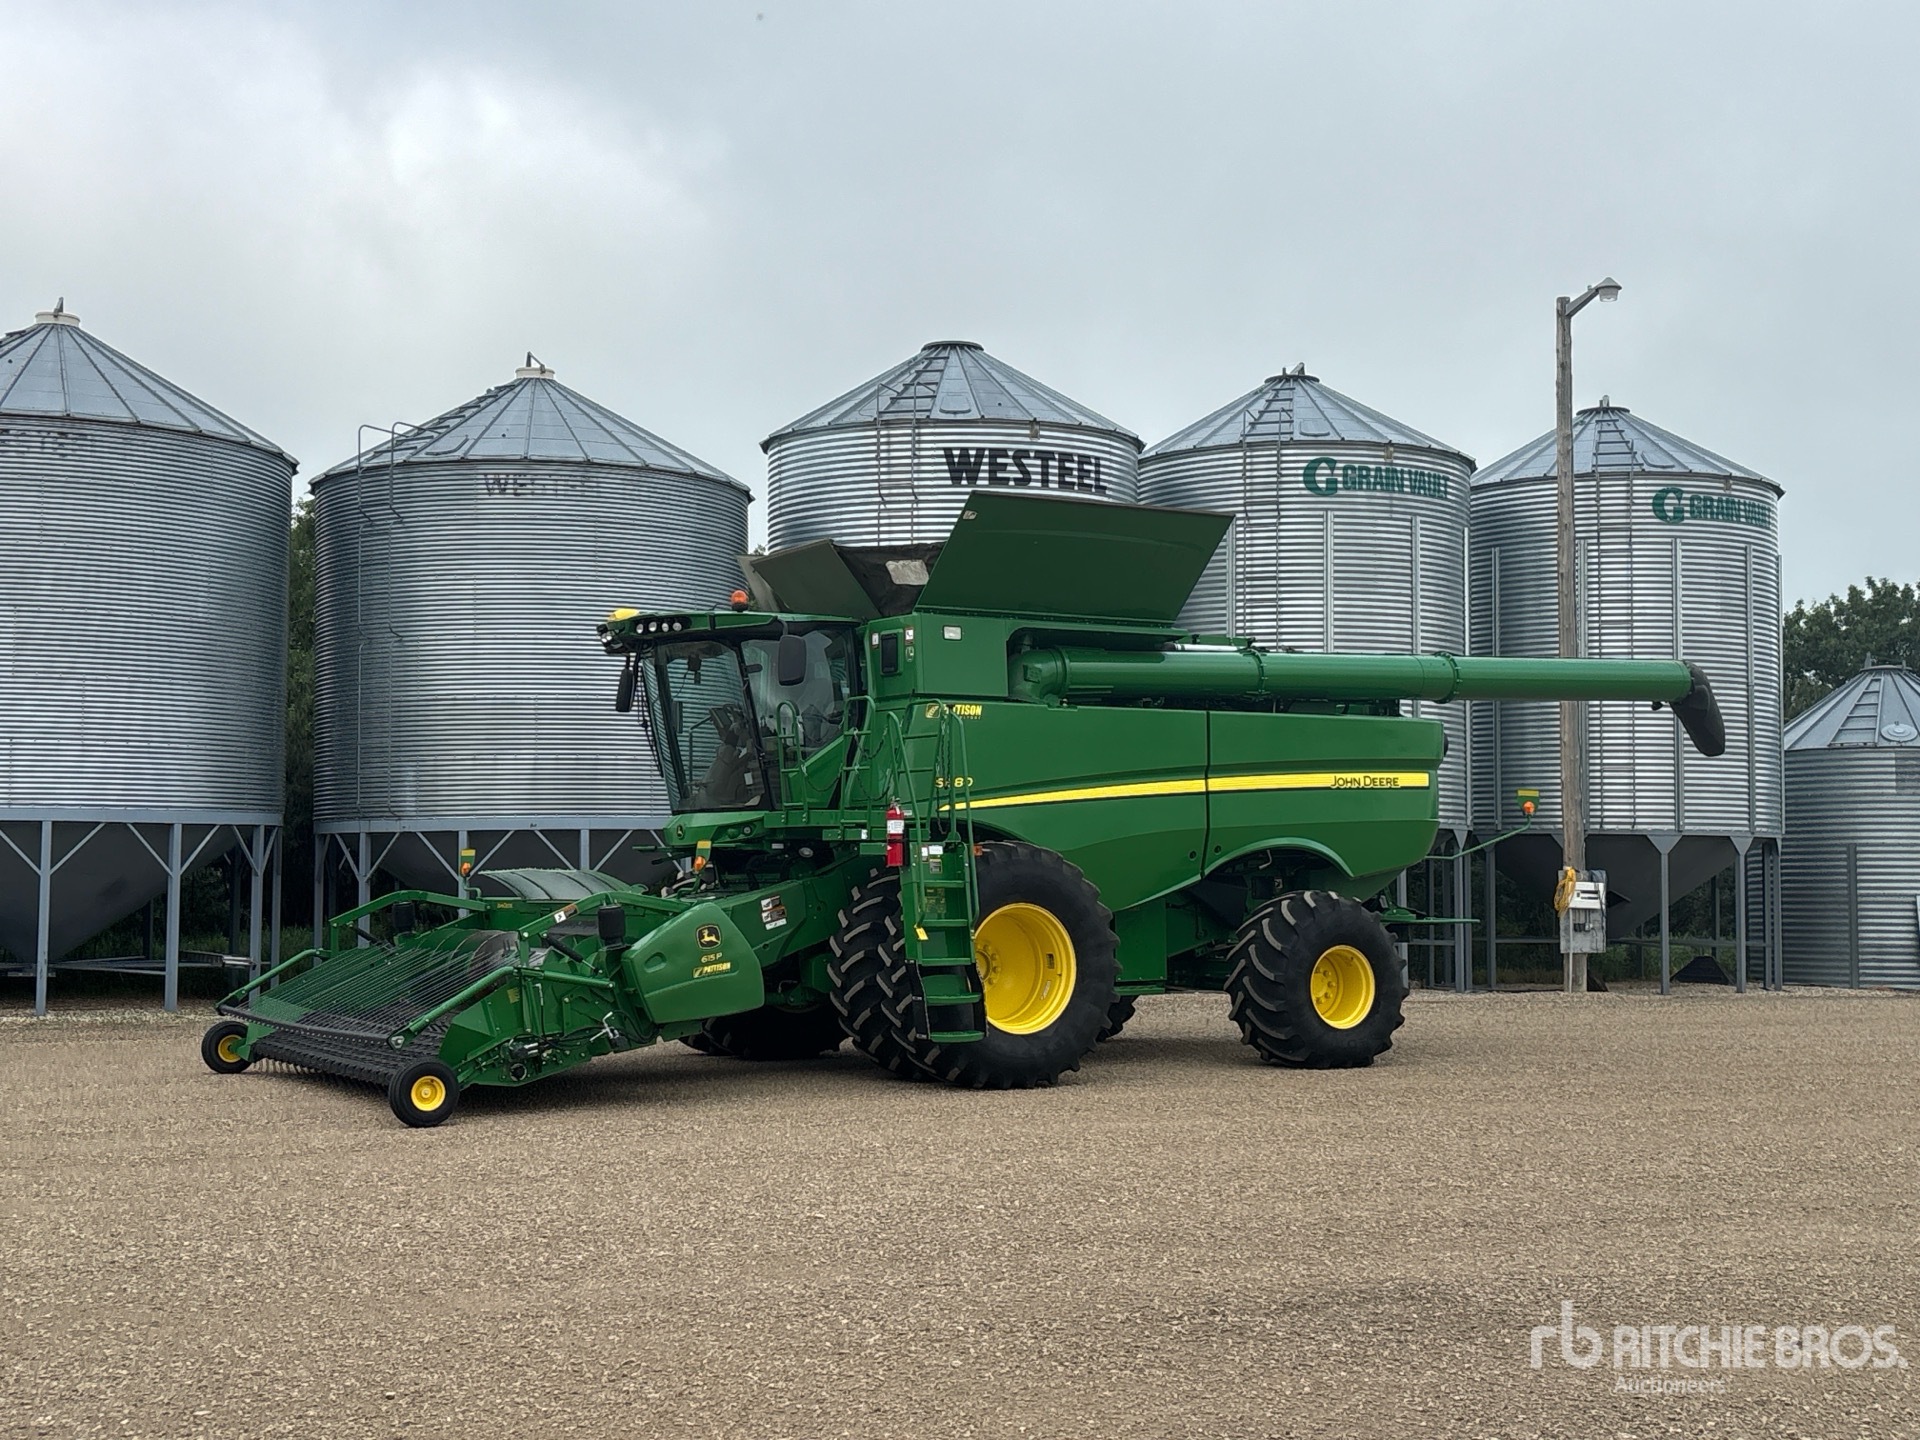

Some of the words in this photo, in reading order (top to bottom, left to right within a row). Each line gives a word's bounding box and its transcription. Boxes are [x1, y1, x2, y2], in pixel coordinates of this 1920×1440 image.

[943, 448, 1107, 495] WESTEEL
[1303, 457, 1338, 496] G
[1342, 464, 1404, 493] GRAIN
[1408, 469, 1450, 499] VAULT
[1652, 487, 1685, 525] G
[1689, 494, 1740, 521] GRAIN
[1331, 775, 1361, 787] JOHN
[1363, 775, 1399, 787] DEERE
